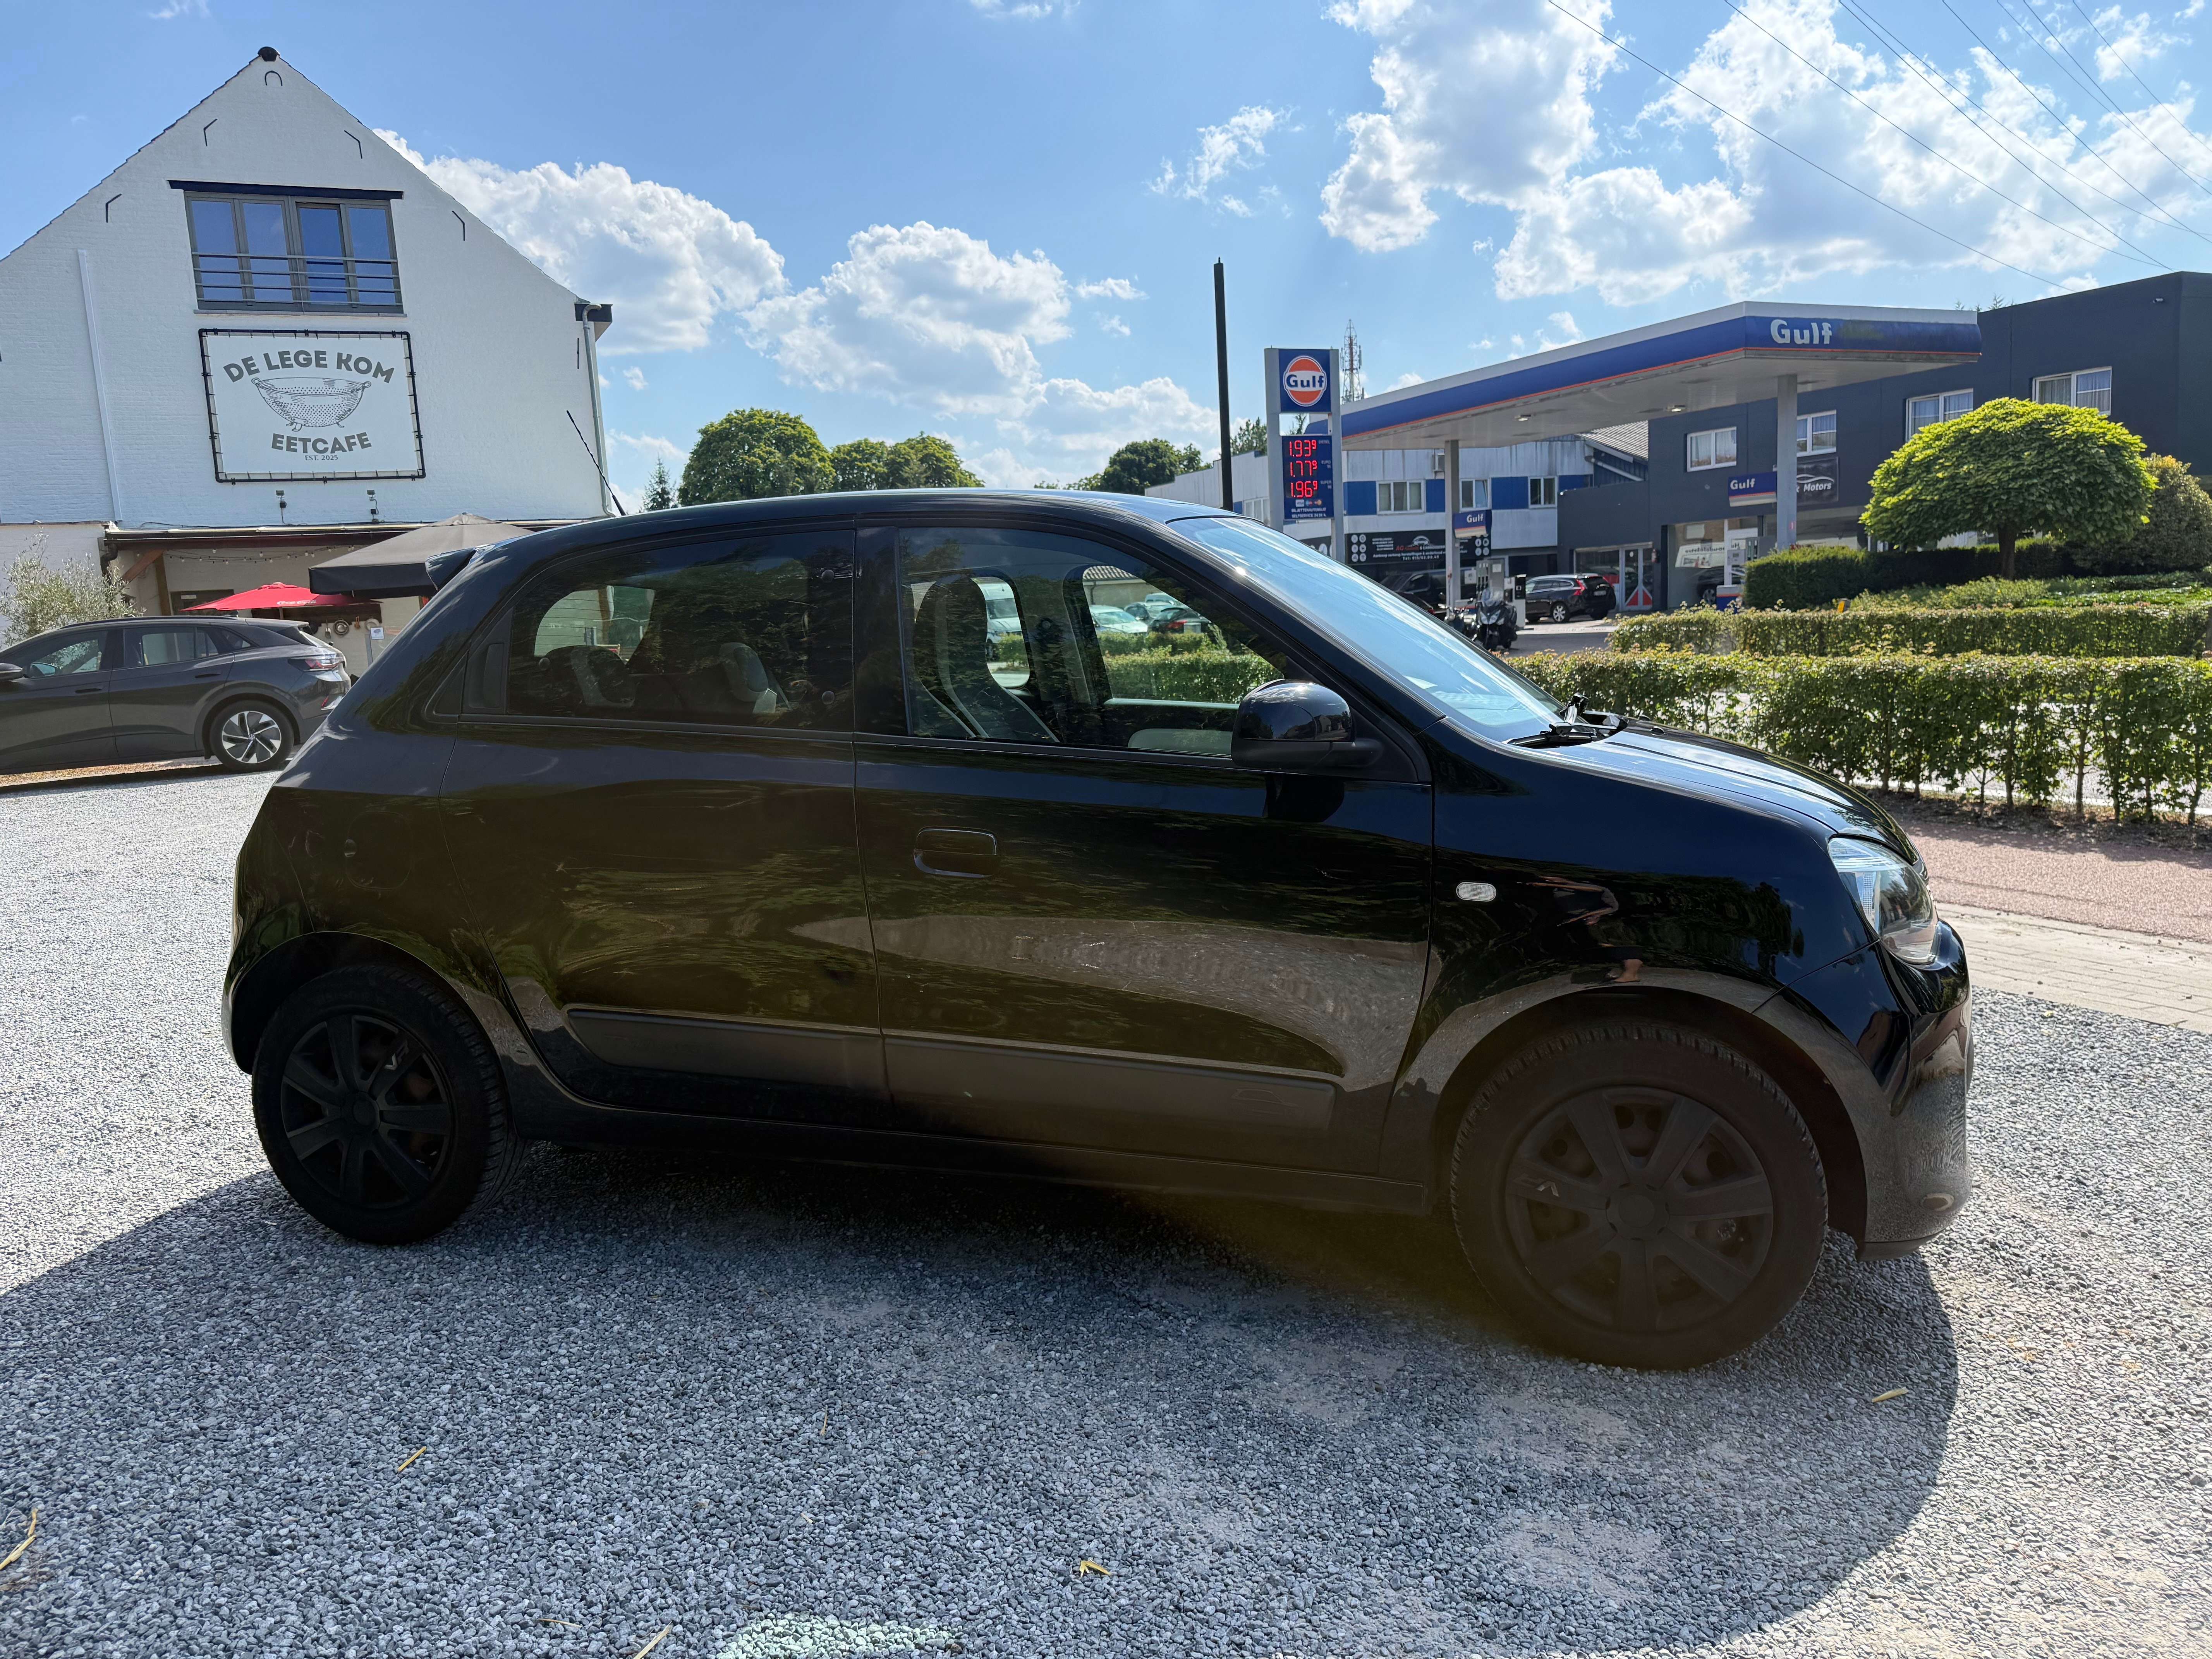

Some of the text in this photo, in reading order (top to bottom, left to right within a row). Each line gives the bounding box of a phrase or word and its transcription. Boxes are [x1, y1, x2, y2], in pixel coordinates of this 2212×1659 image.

[1770, 319, 1832, 345] Gulf
[223, 350, 394, 383] DE LEGE KOM
[1286, 374, 1324, 388] Gulf
[271, 432, 372, 454] EETCAFE
[1730, 478, 1755, 490] Gulf
[1803, 483, 1832, 492] Motors
[1467, 514, 1483, 523] Gulf
